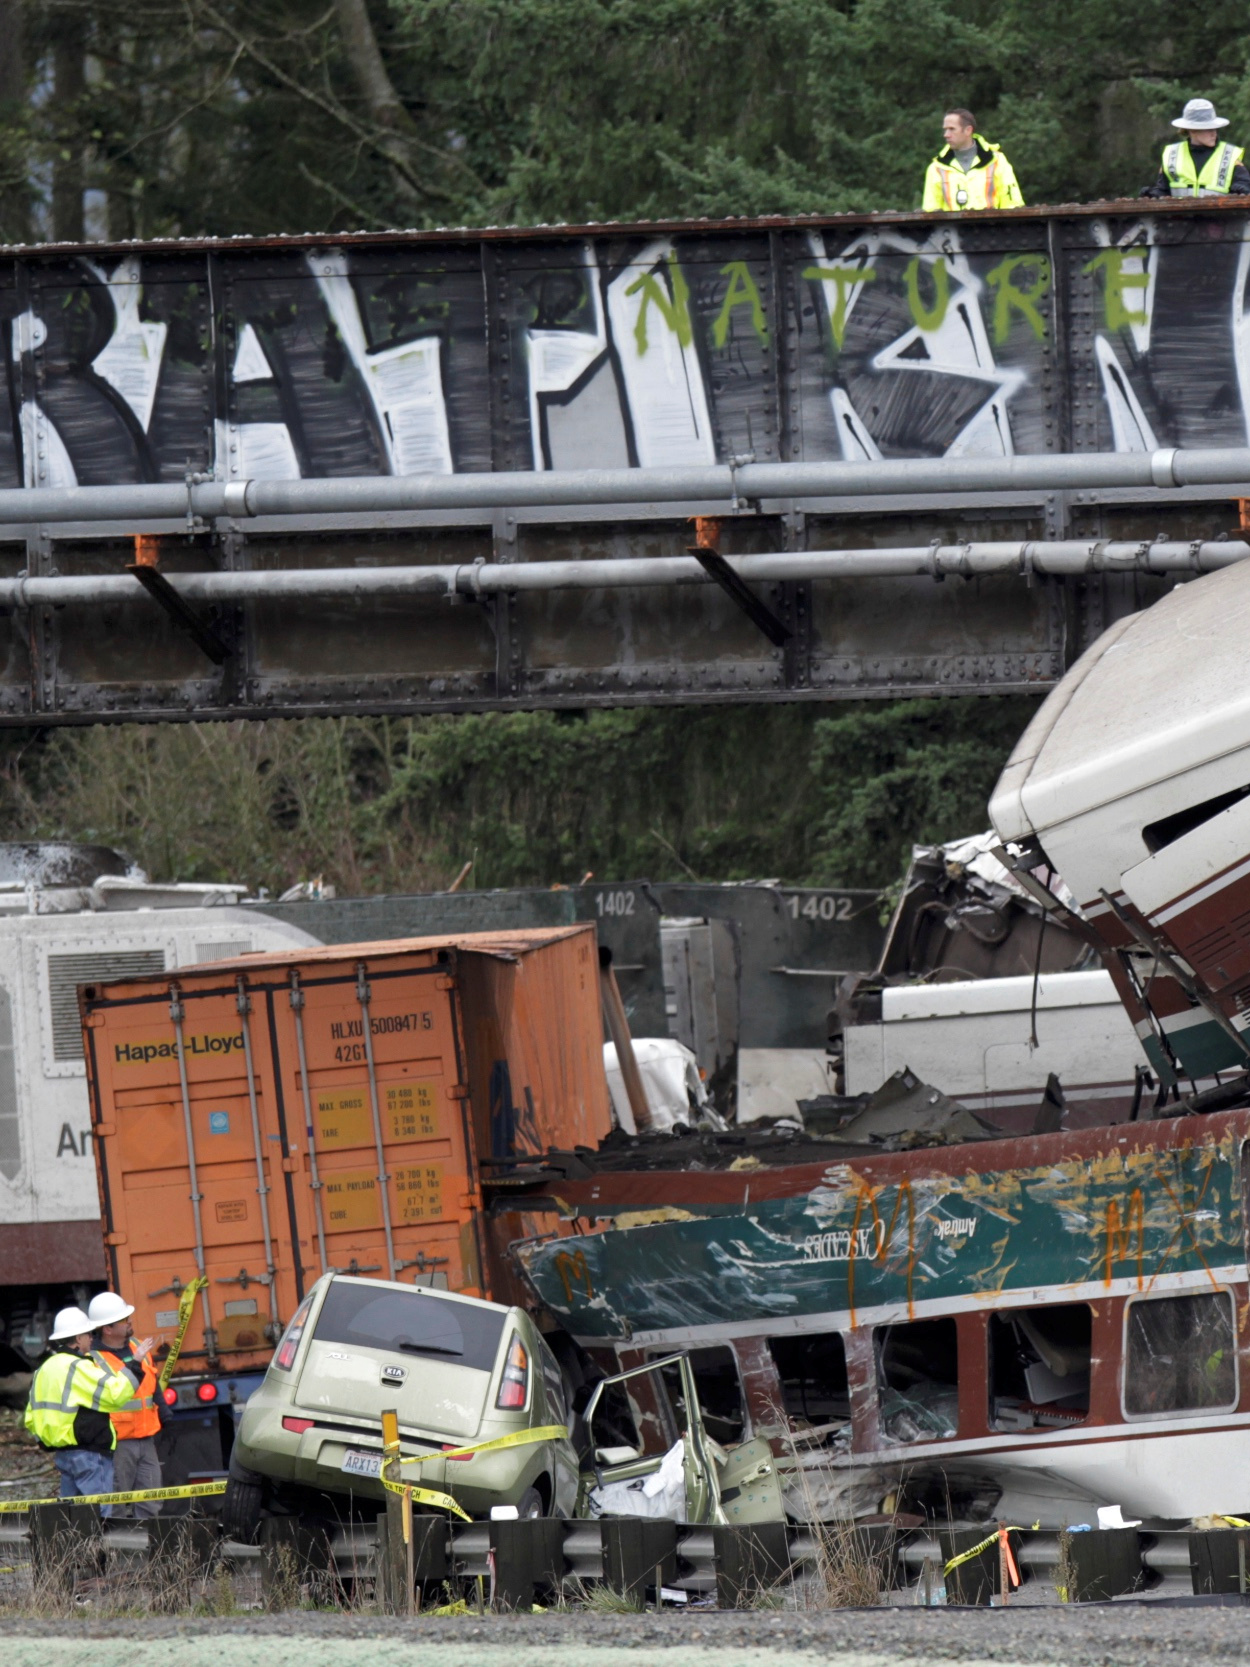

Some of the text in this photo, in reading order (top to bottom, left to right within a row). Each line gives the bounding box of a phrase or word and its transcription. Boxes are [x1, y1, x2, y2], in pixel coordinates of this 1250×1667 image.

[1217, 150, 1230, 187] PATROL
[597, 890, 635, 917] 1402
[787, 896, 852, 921] 1402
[331, 1012, 431, 1040] HLXU 500847 5
[115, 1031, 246, 1063] Hapag-Lloyd
[335, 1044, 367, 1062] 42G1
[340, 1099, 363, 1109] GROSS
[322, 1128, 339, 1139] TARE
[347, 1180, 375, 1191] PAYLOAD
[330, 1209, 347, 1220] CUBE
[804, 1219, 886, 1261] CASCADES
[386, 1367, 402, 1376] KIA
[345, 1455, 382, 1473] ARX13
